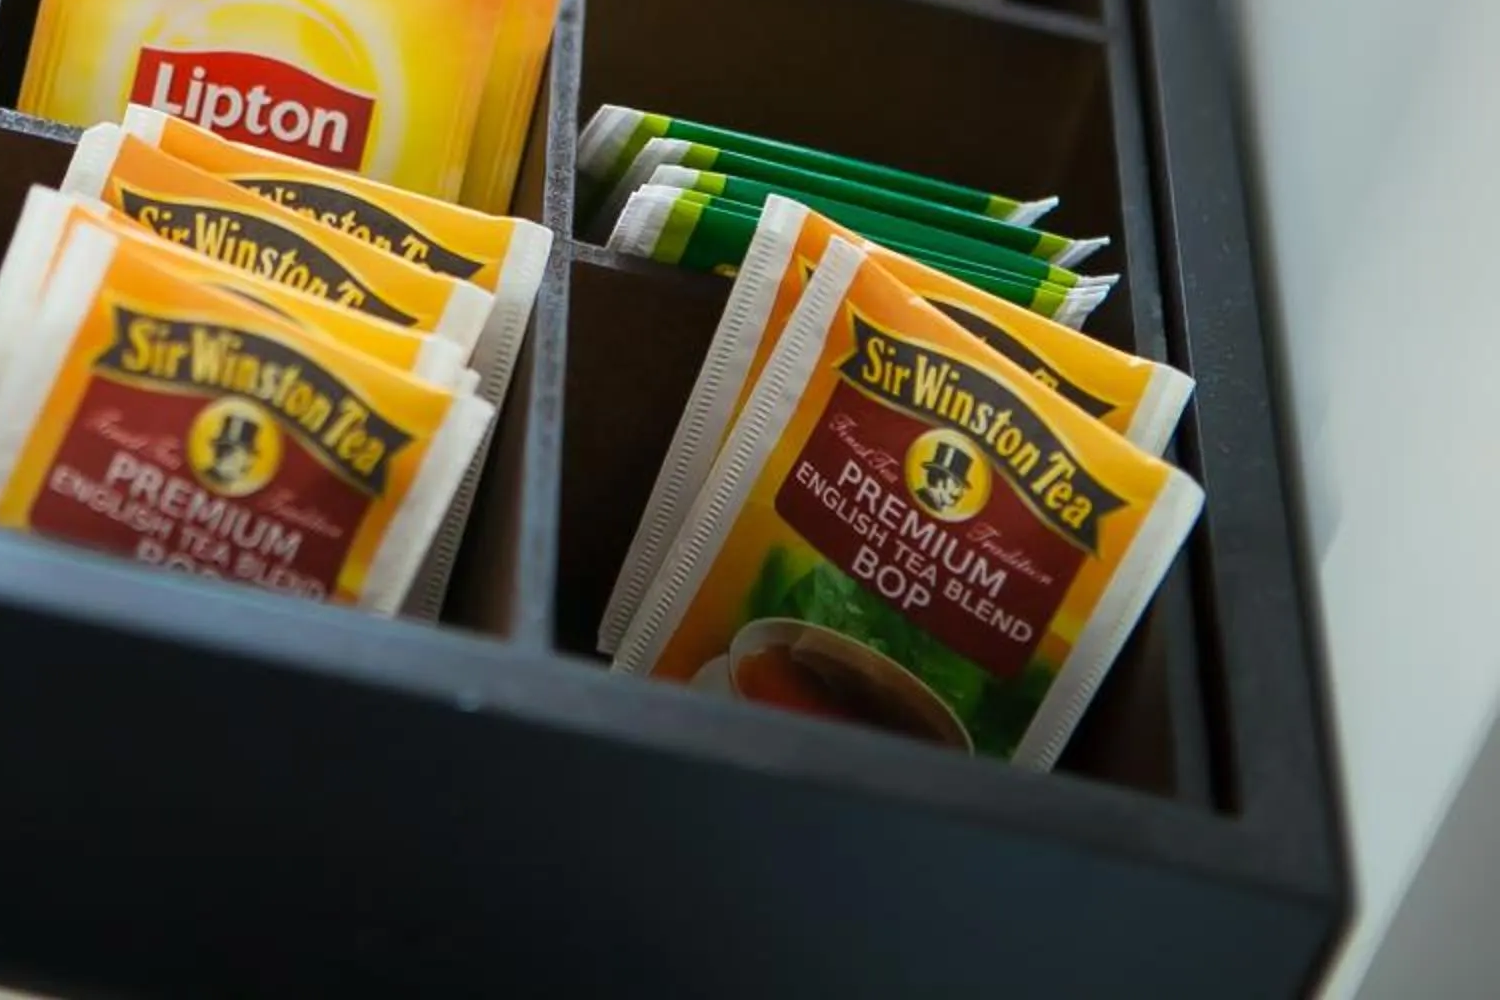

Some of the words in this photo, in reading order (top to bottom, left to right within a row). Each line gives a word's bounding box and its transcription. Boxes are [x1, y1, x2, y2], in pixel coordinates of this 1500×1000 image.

[151, 62, 349, 152] Lipton
[121, 320, 188, 379] Sir
[190, 325, 332, 432] Winston
[324, 399, 387, 476] Tea
[861, 336, 912, 396] Sir
[912, 353, 1042, 477] Winston
[1028, 452, 1094, 530] Tea
[50, 464, 175, 541] ENGLISH
[179, 527, 230, 569] TEA
[105, 451, 303, 563] PREMIUM
[795, 461, 890, 549] ENGLISH
[893, 540, 938, 588] TEA
[943, 579, 1034, 644] BLEND
[837, 459, 1008, 599] PREMIUM
[851, 545, 932, 611] BOP
